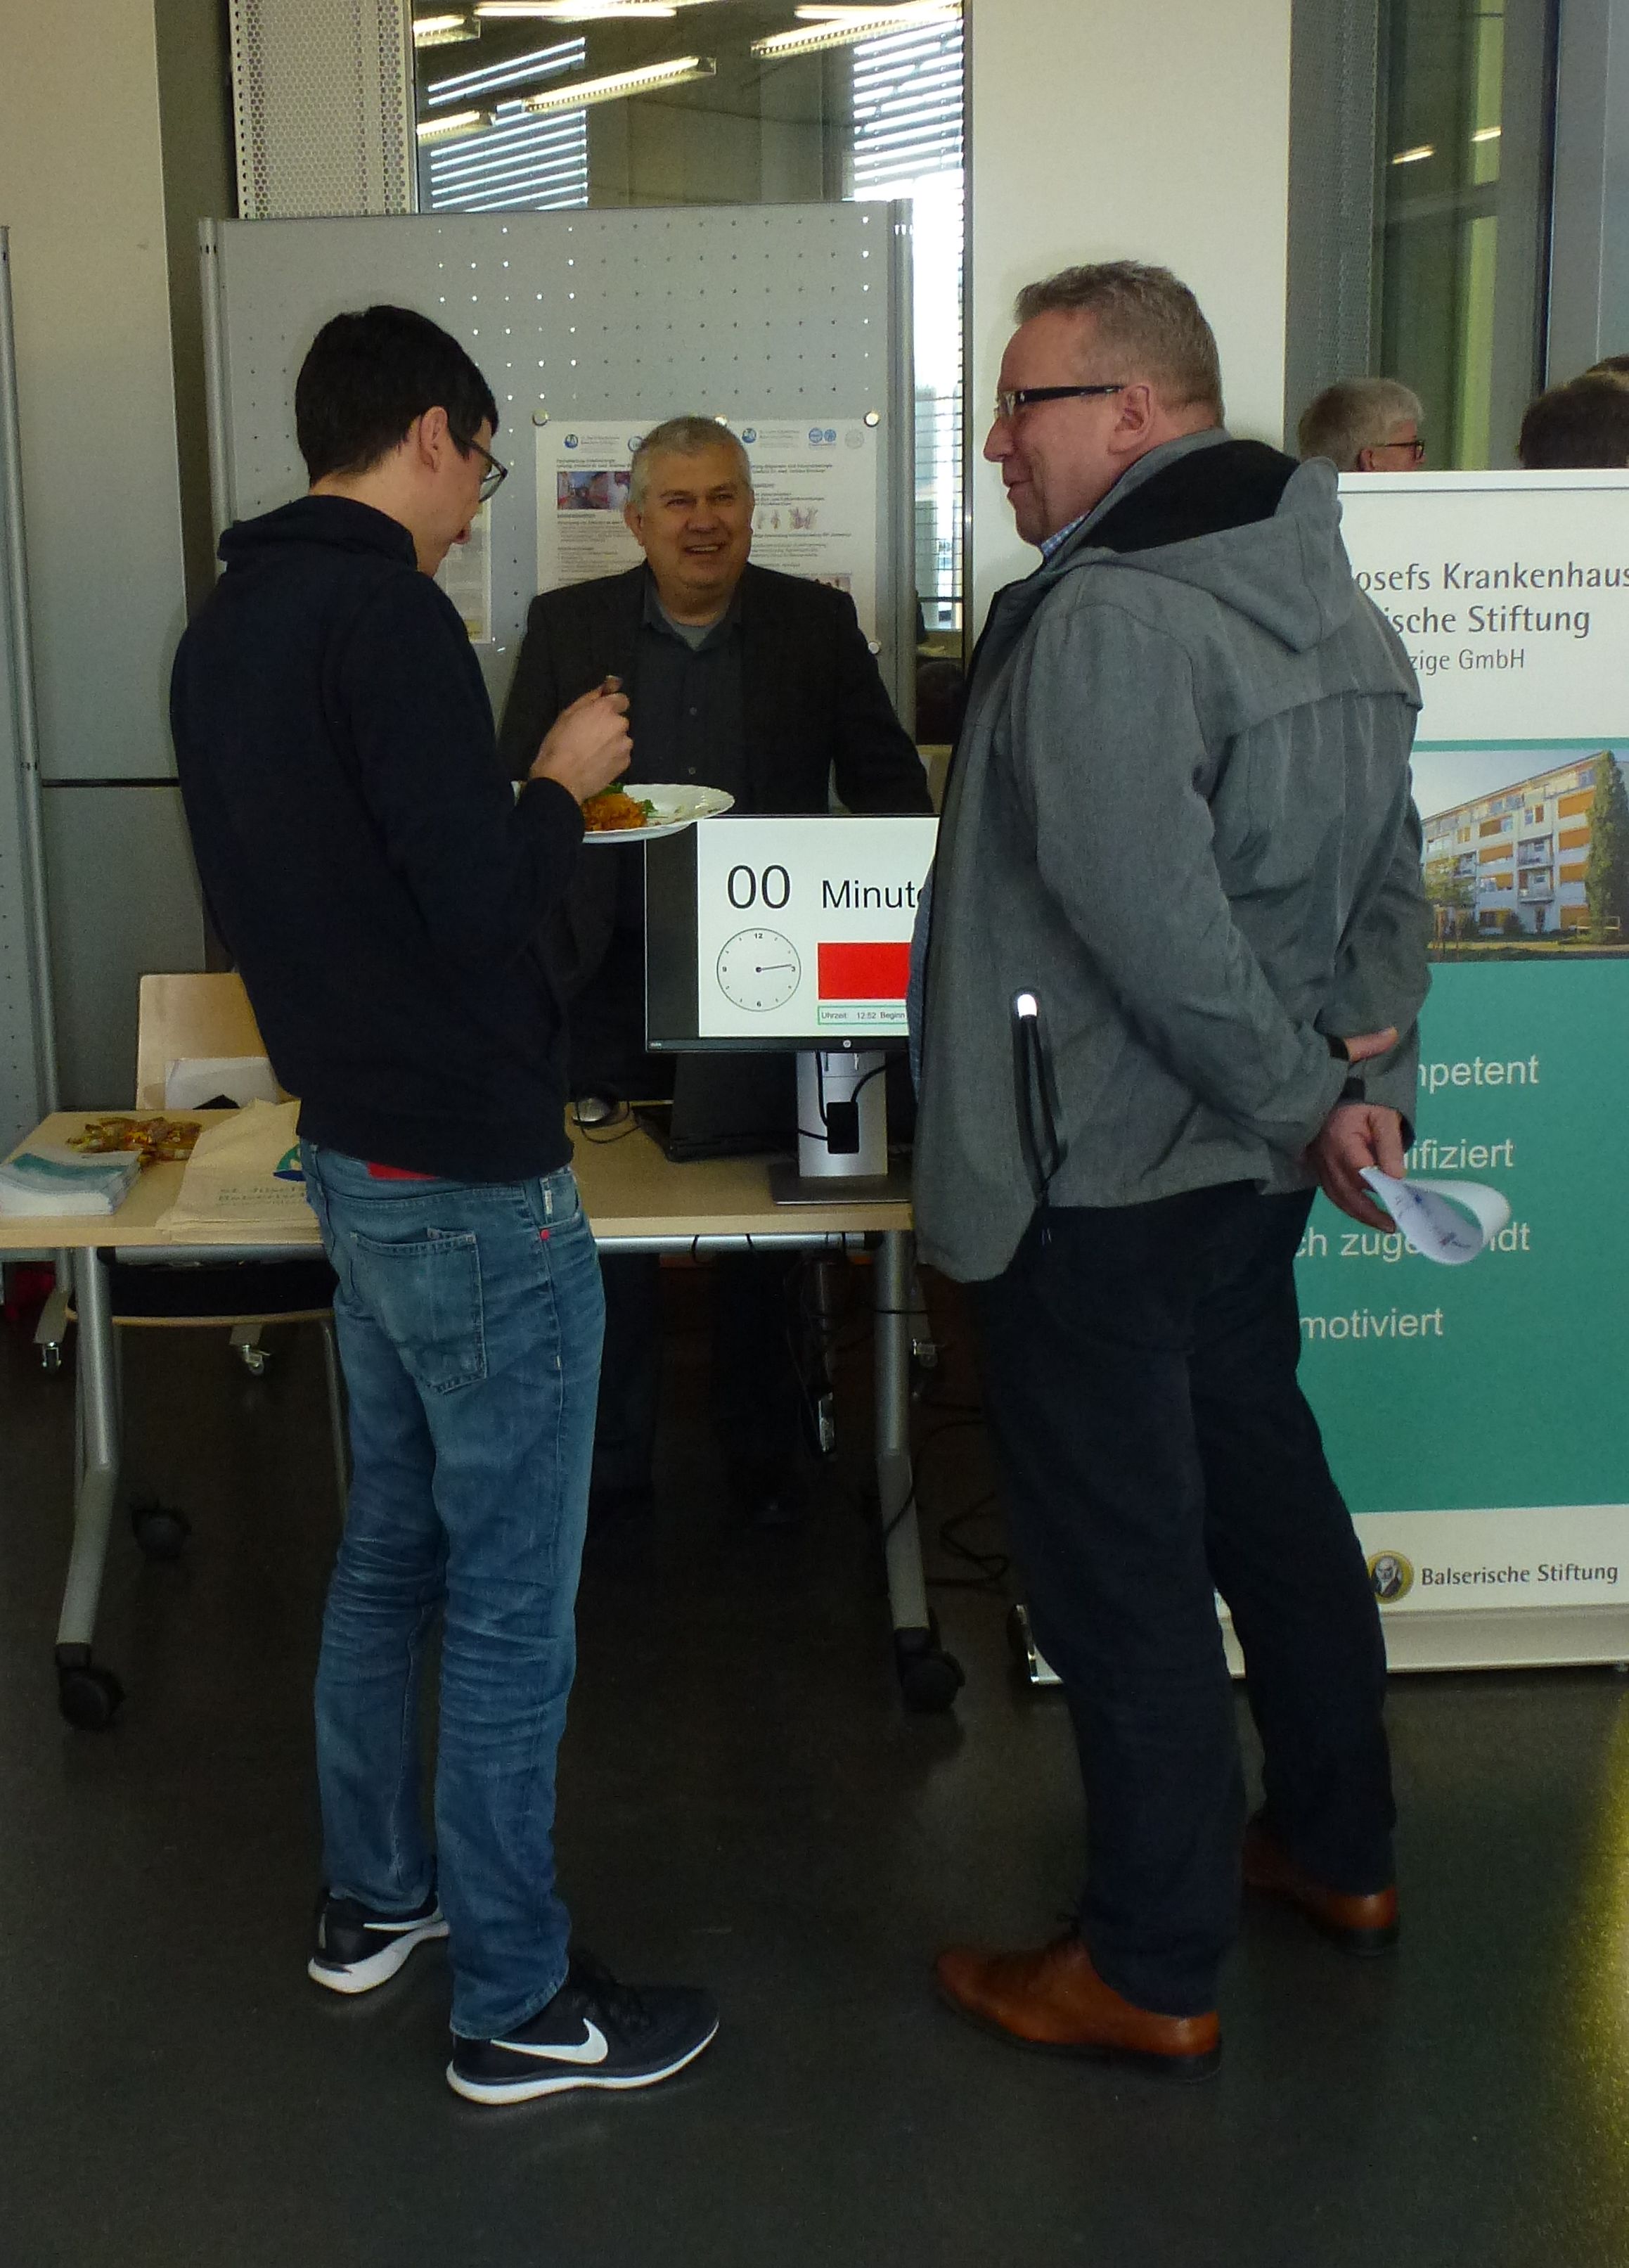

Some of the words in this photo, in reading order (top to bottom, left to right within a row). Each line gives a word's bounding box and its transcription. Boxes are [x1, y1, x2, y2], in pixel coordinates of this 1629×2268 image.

[1355, 563, 1431, 591] osefs
[1443, 561, 1629, 590] Krankenhaus
[1468, 605, 1591, 639] Stiftung
[1459, 648, 1525, 670] GmbH
[727, 864, 791, 910] 00
[822, 879, 923, 909] Minut
[1299, 1308, 1444, 1340] motiviert
[1422, 1566, 1531, 1587] Balserische
[1538, 1563, 1618, 1584] Stiftung
